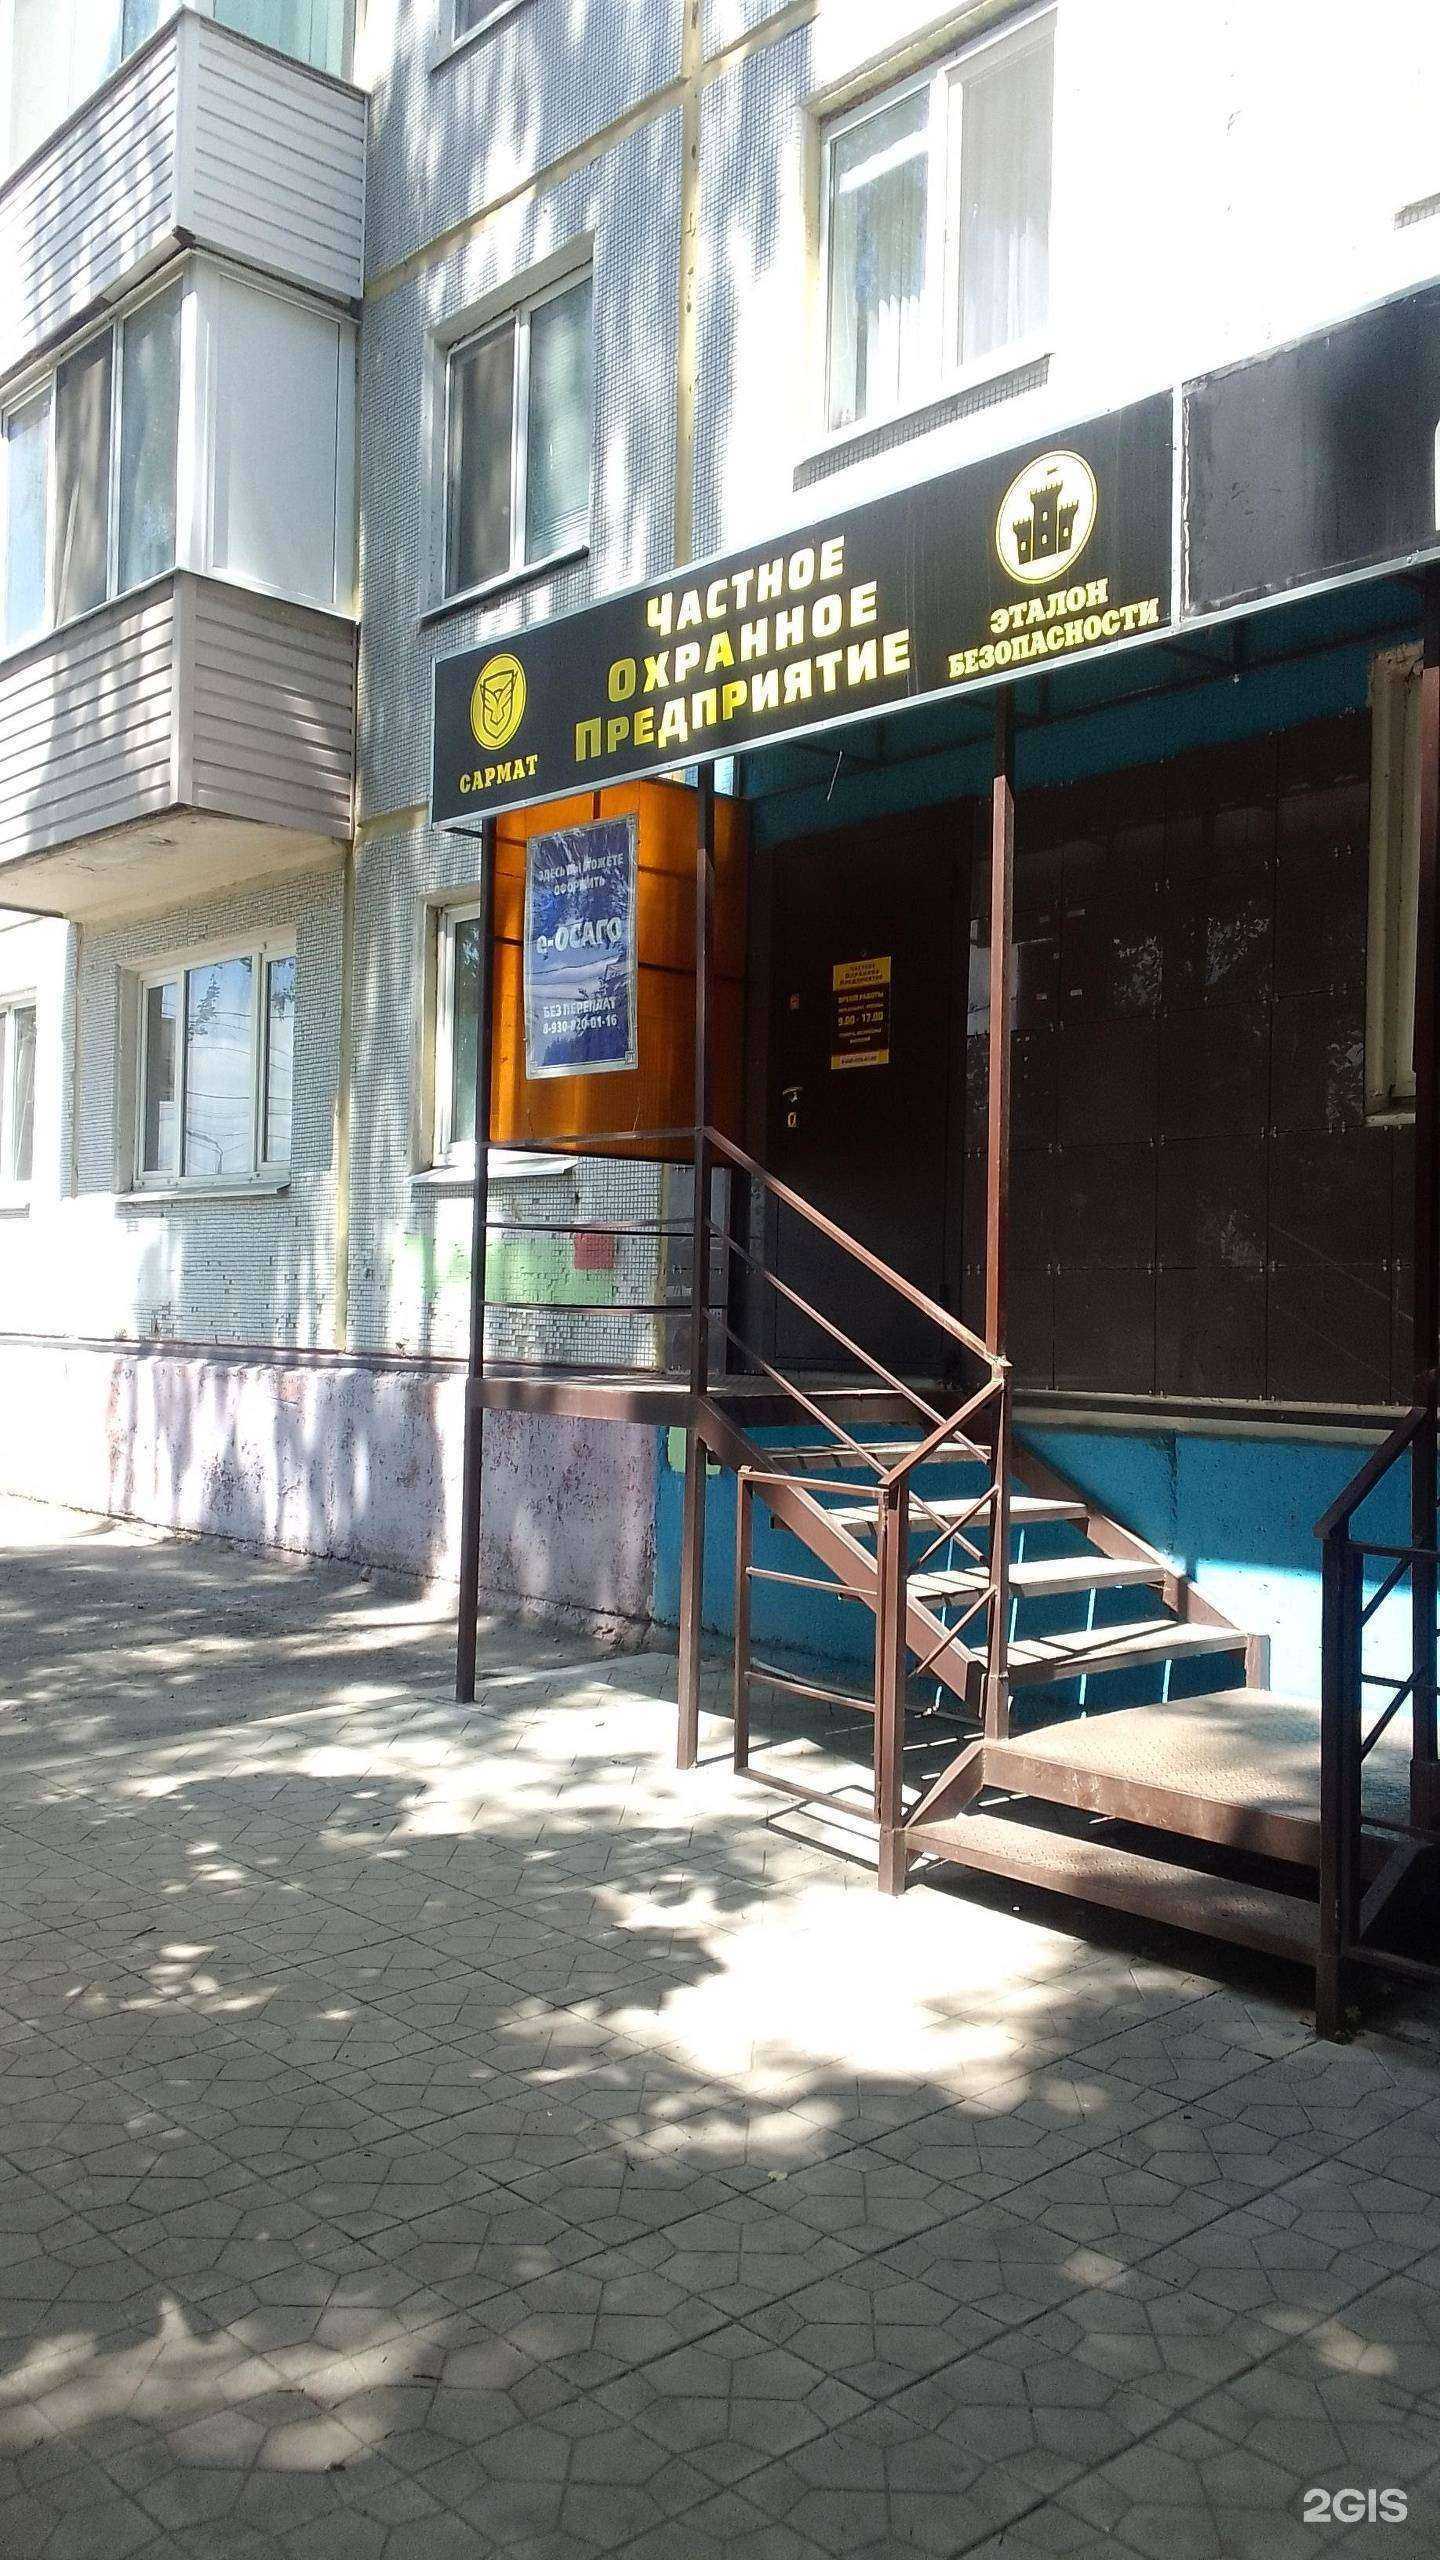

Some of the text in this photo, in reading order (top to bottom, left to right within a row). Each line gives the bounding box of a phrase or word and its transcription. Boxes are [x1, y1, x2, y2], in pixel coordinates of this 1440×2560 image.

[646, 535, 846, 638] ЧАСТНОЕ
[990, 577, 1109, 634] ЭТАЛОН
[607, 581, 878, 704] ОХРАННОЕ
[947, 597, 1160, 679] БЕЗОПАСНОСТИ
[575, 628, 912, 763] ПРЕДПРИЯТИЕ
[458, 753, 539, 795] САРМАТ
[543, 996, 616, 1019] БЕЗ ПЕРЕПЛАТ
